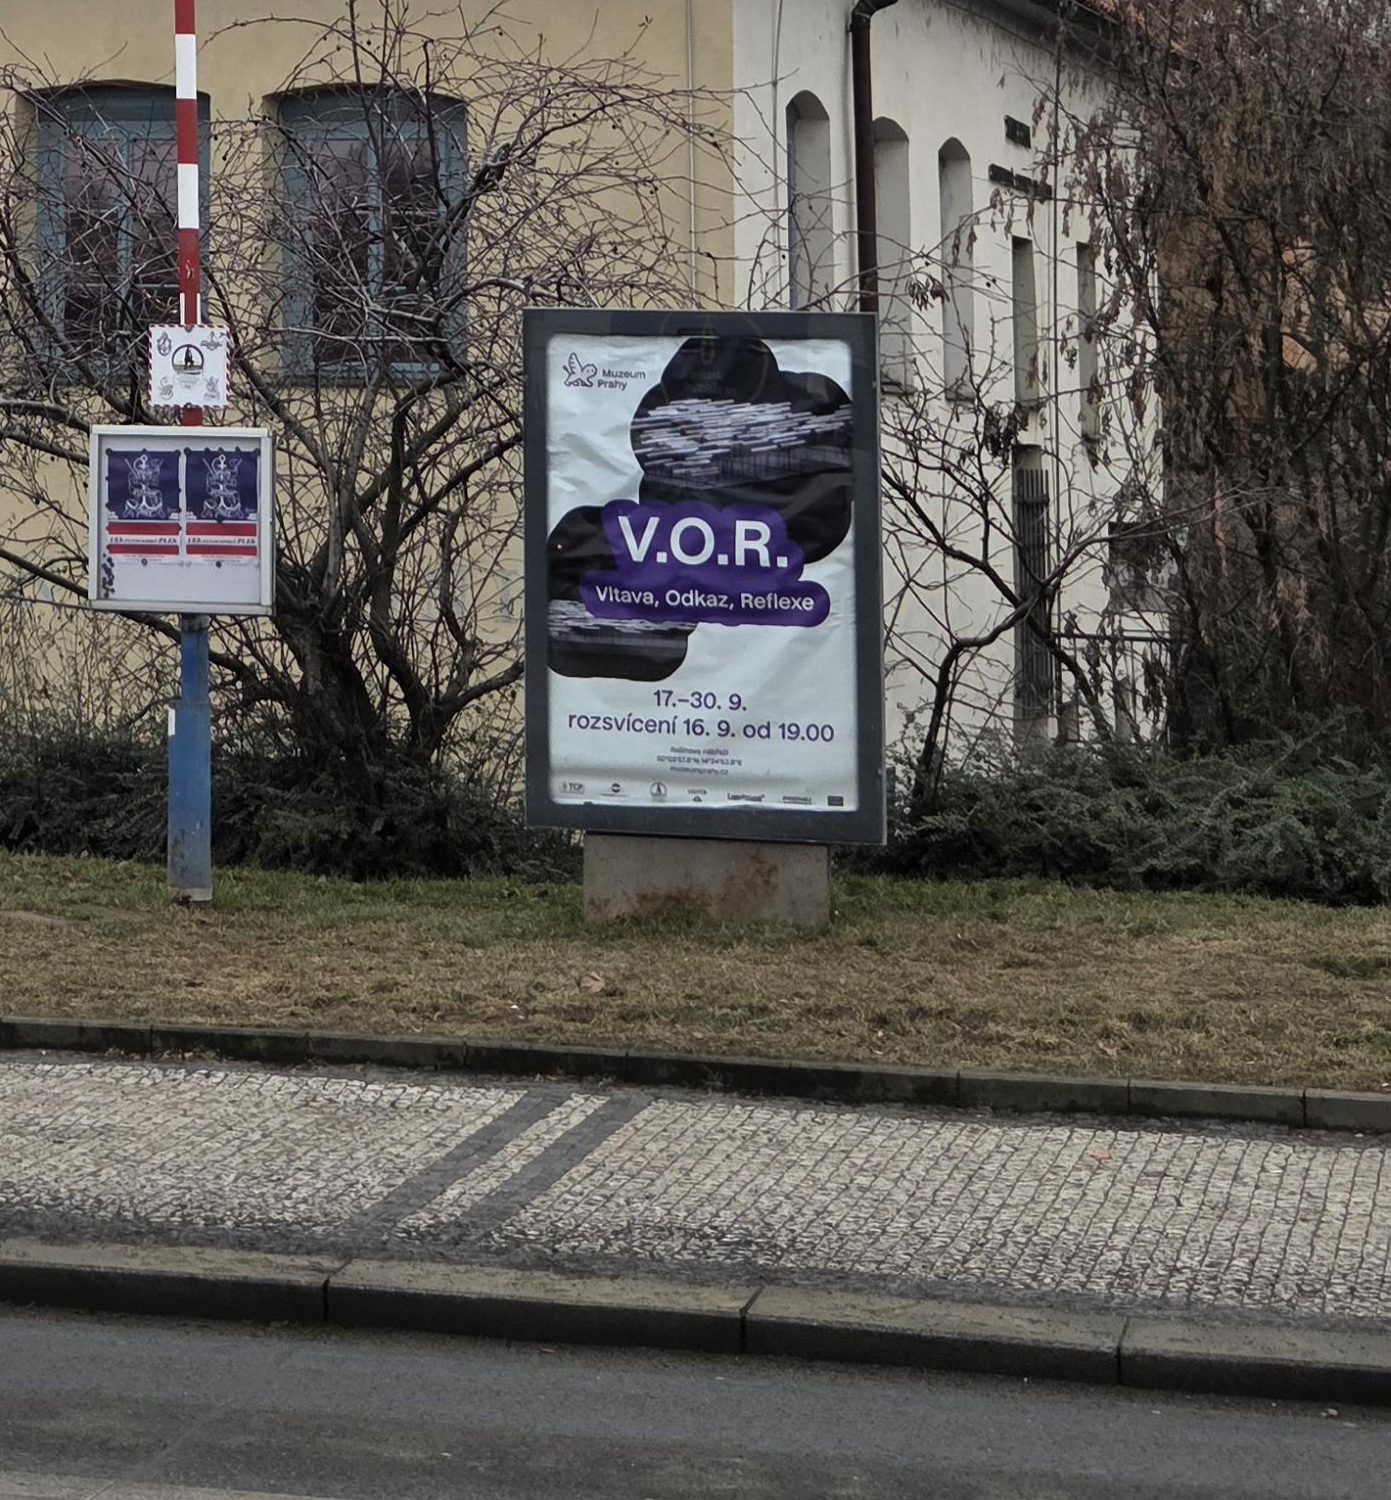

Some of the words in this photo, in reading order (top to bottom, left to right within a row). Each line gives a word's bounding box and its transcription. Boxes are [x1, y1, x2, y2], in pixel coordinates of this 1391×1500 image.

[602, 368, 646, 379] Muzeum
[597, 379, 627, 391] Prahy
[618, 515, 788, 568] V.O.R.
[596, 585, 659, 608] Vltava,
[665, 589, 735, 610] Odkaz,
[741, 592, 815, 611] Reflexe
[728, 693, 747, 711] 9.
[568, 712, 678, 735] rozsvícení
[682, 718, 710, 736] 16.
[716, 720, 736, 738] 9.
[742, 721, 771, 739] od
[778, 722, 835, 743] 19.00
